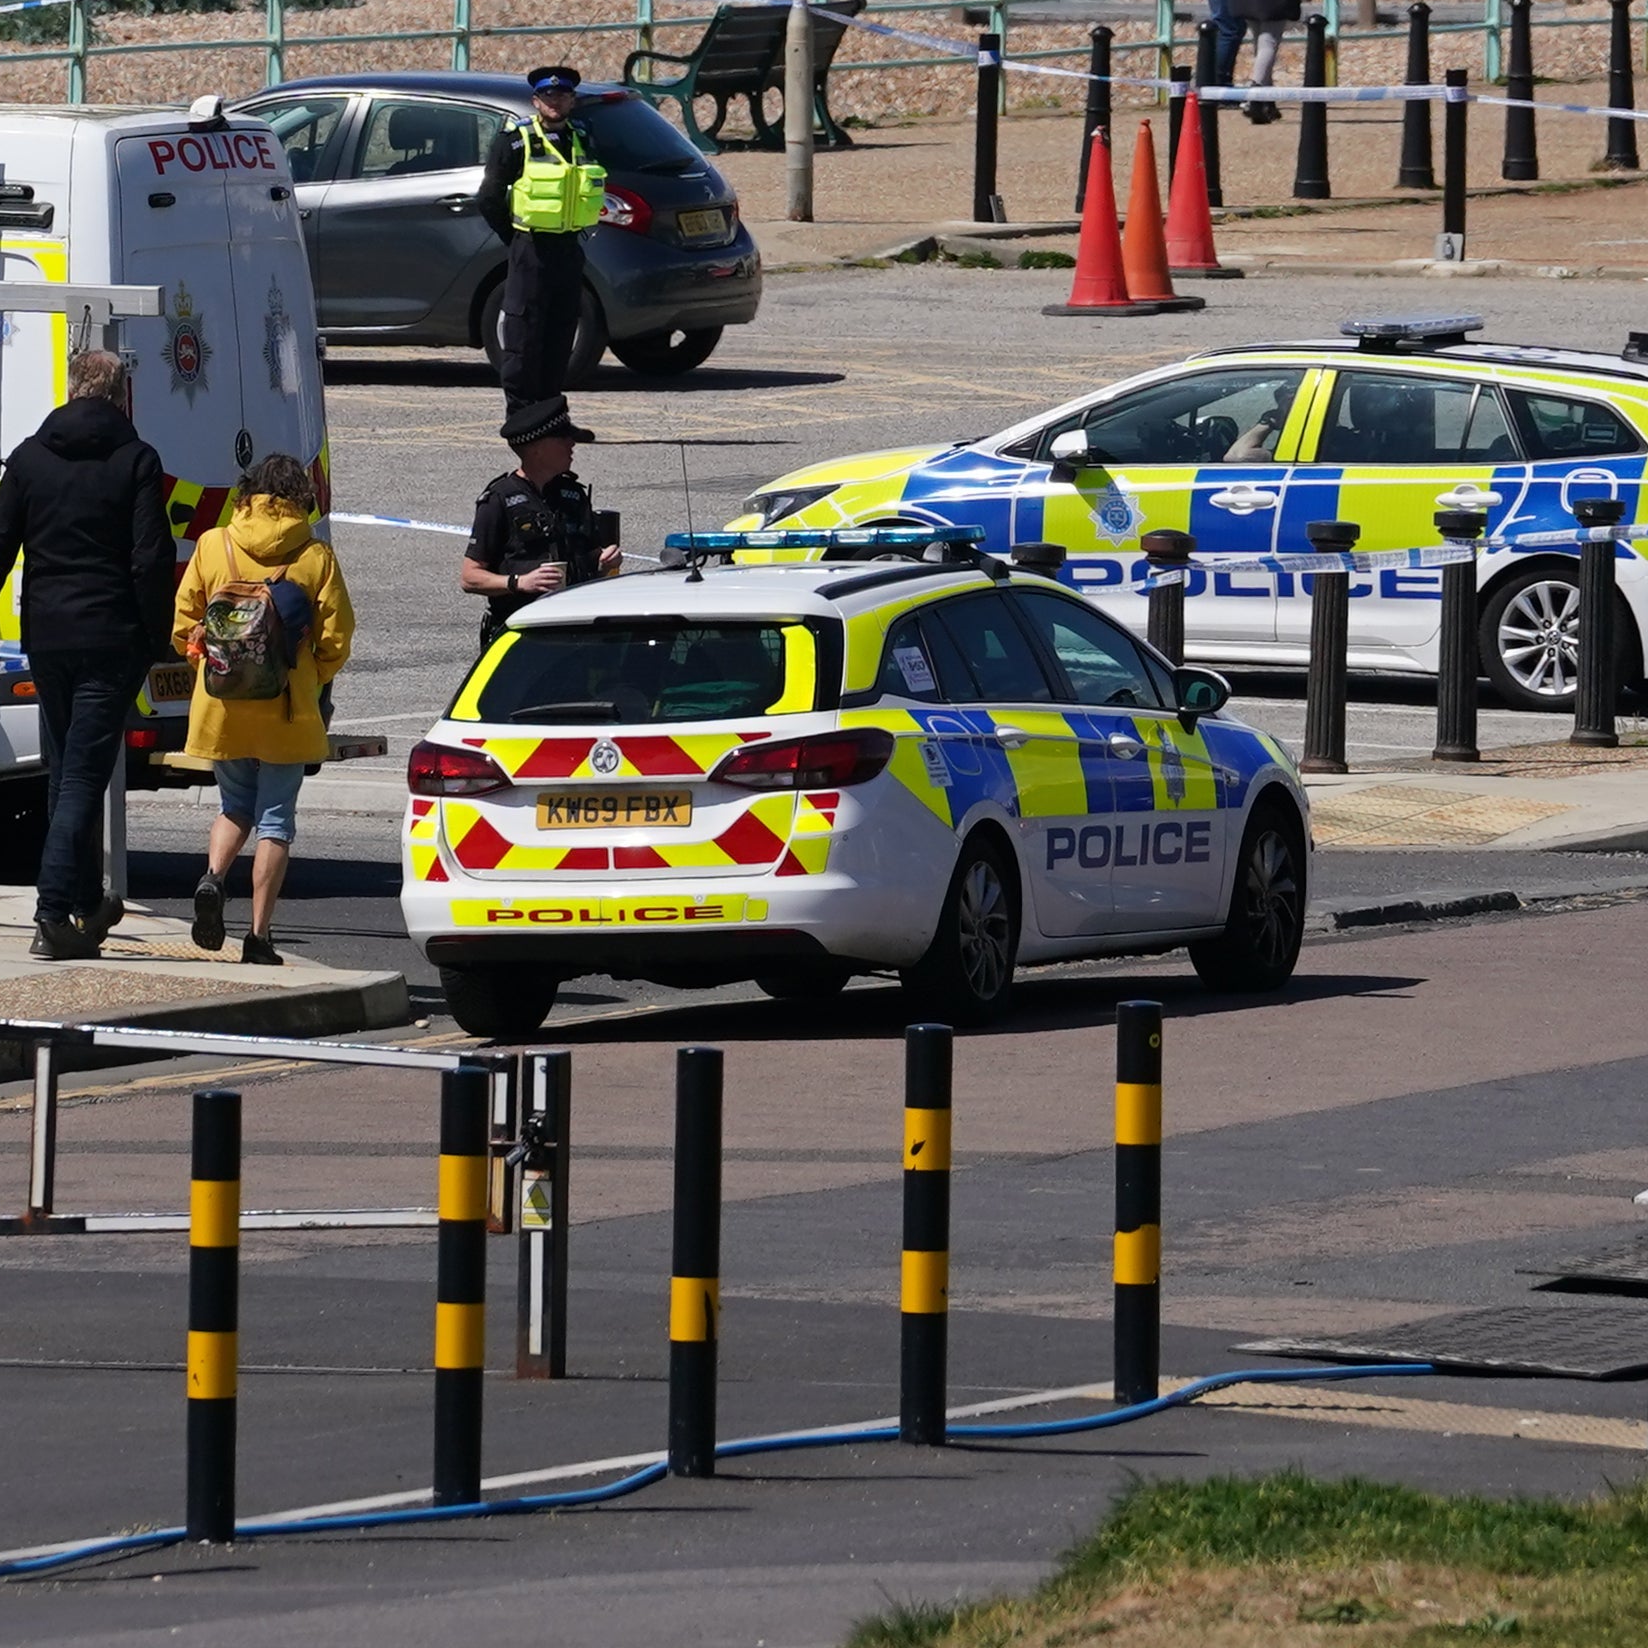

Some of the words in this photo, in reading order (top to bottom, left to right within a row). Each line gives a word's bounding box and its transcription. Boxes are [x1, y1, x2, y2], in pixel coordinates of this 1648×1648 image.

[147, 135, 276, 176] POLICE
[547, 796, 617, 825] KW69
[625, 795, 679, 823] FBX
[1046, 820, 1211, 871] POLICE
[487, 905, 724, 923] POLICE
